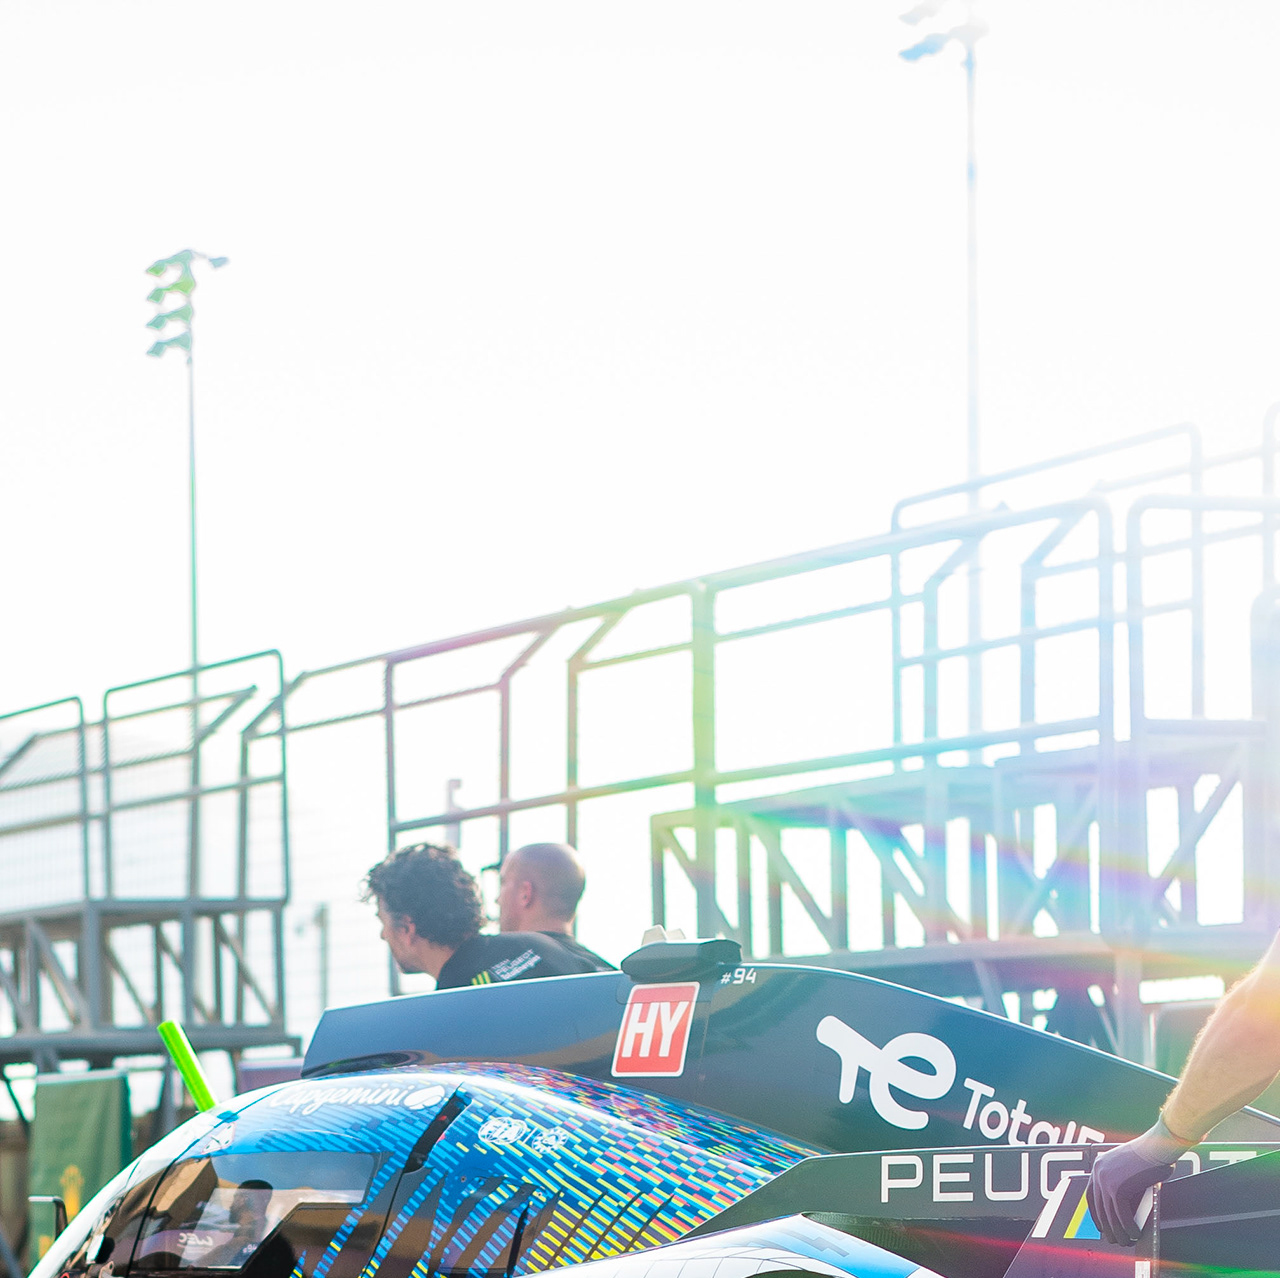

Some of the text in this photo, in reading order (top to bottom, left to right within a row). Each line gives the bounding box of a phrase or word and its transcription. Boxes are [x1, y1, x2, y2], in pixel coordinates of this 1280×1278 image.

[721, 966, 757, 986] #94
[621, 1001, 691, 1058] HY
[269, 1082, 416, 1116] Capgemini
[880, 1150, 1258, 1204] PEUG
